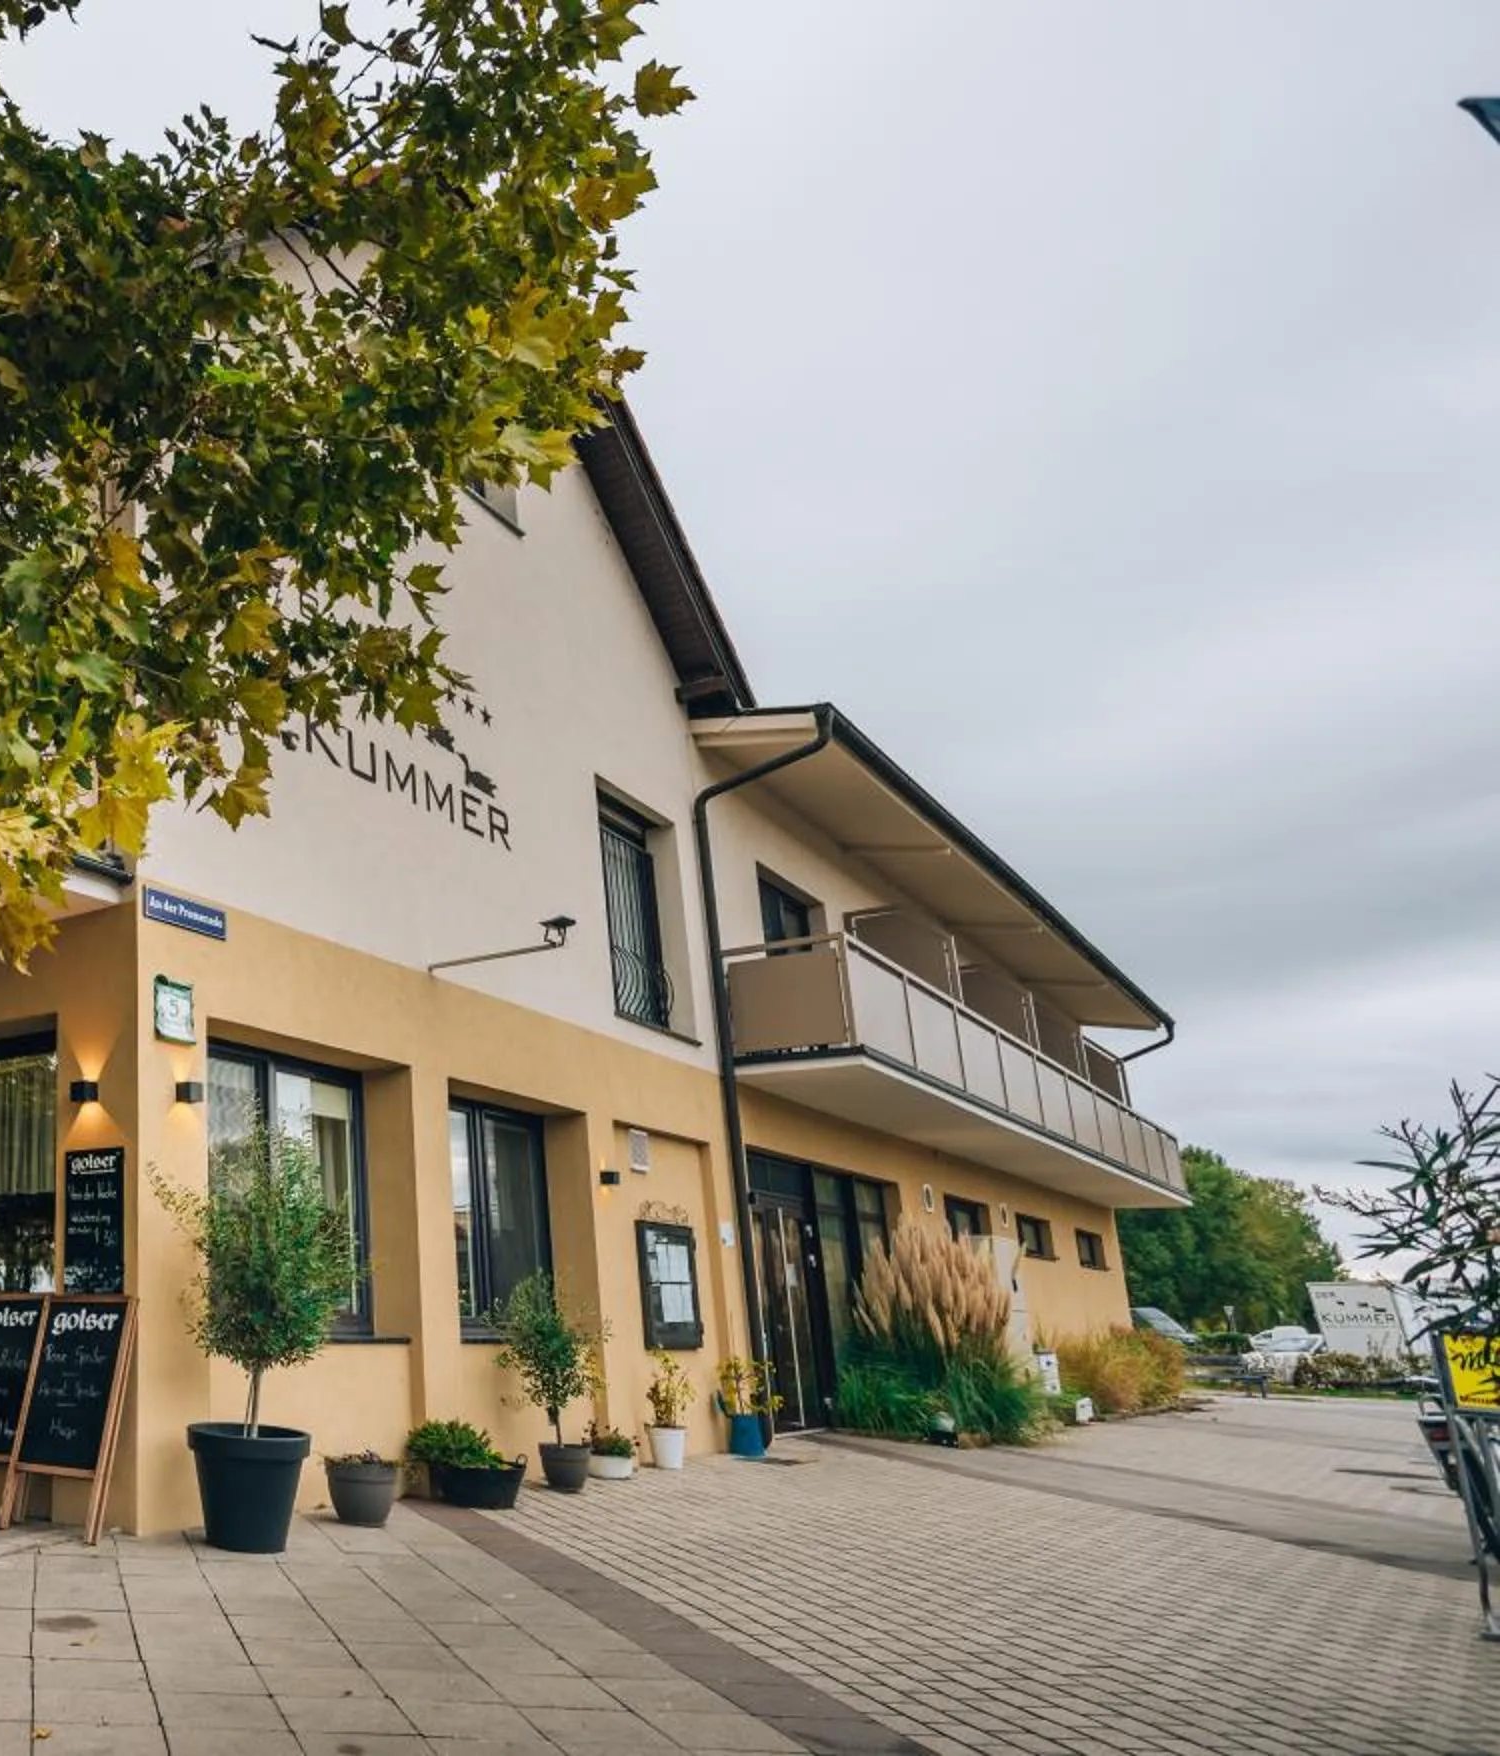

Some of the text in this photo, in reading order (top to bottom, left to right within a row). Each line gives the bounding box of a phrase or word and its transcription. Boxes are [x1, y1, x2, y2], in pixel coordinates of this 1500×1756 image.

[306, 714, 511, 851] KUMMER
[149, 895, 162, 909] An
[169, 999, 179, 1018] 5
[71, 1154, 116, 1175] golser
[51, 1308, 119, 1335] golser
[1321, 1313, 1395, 1324] KUMMER
